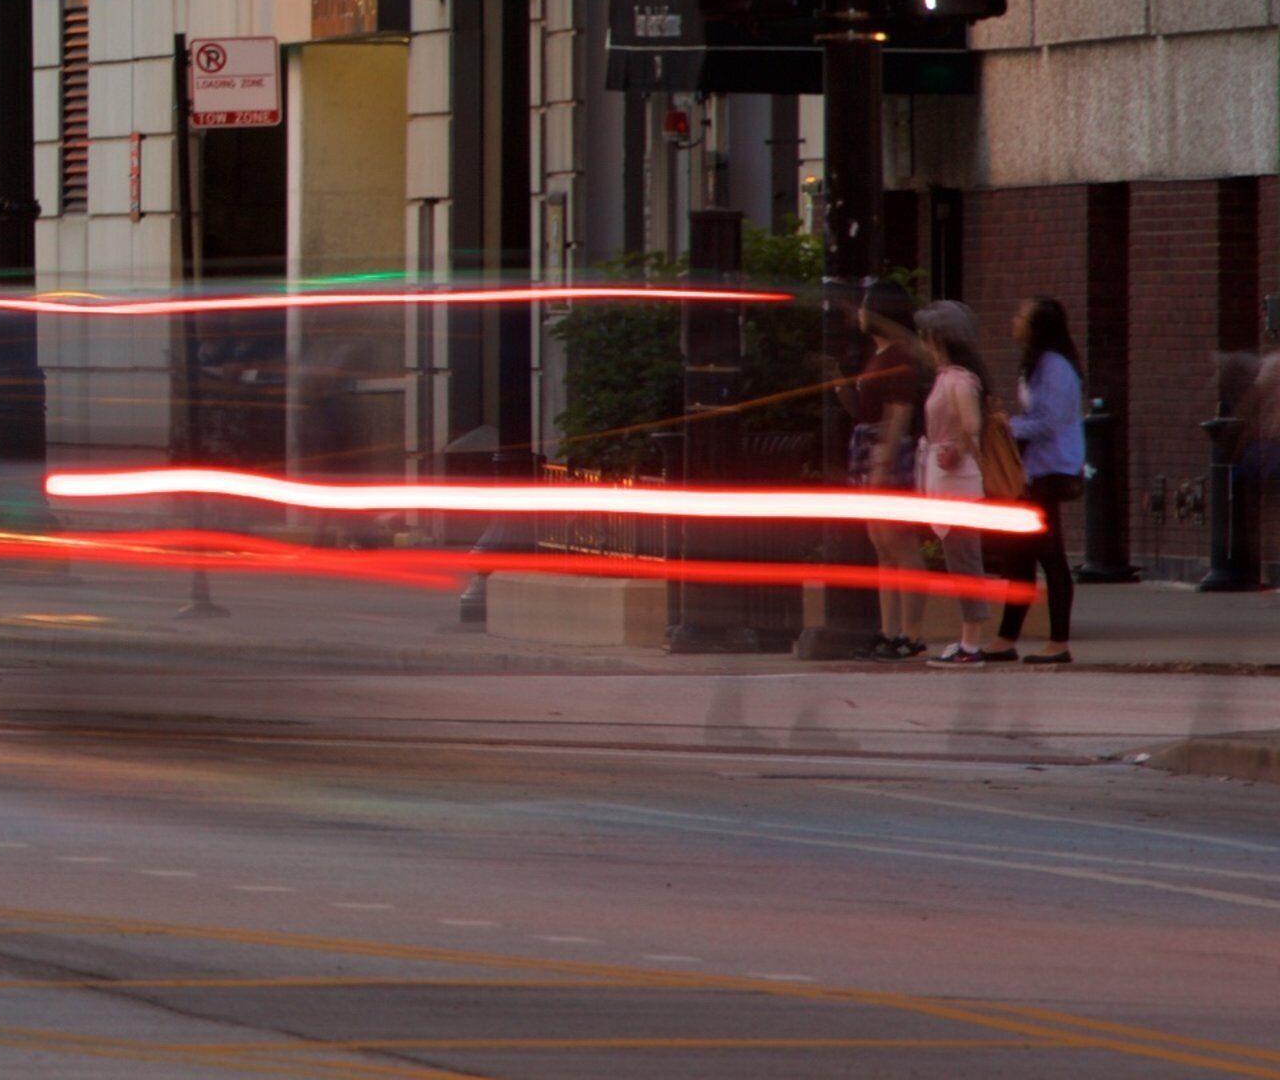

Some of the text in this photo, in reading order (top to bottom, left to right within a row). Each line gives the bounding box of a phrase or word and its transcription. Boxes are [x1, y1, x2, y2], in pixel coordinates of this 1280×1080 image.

[241, 79, 265, 88] ZONE
[197, 112, 271, 125] TOW ZONE
